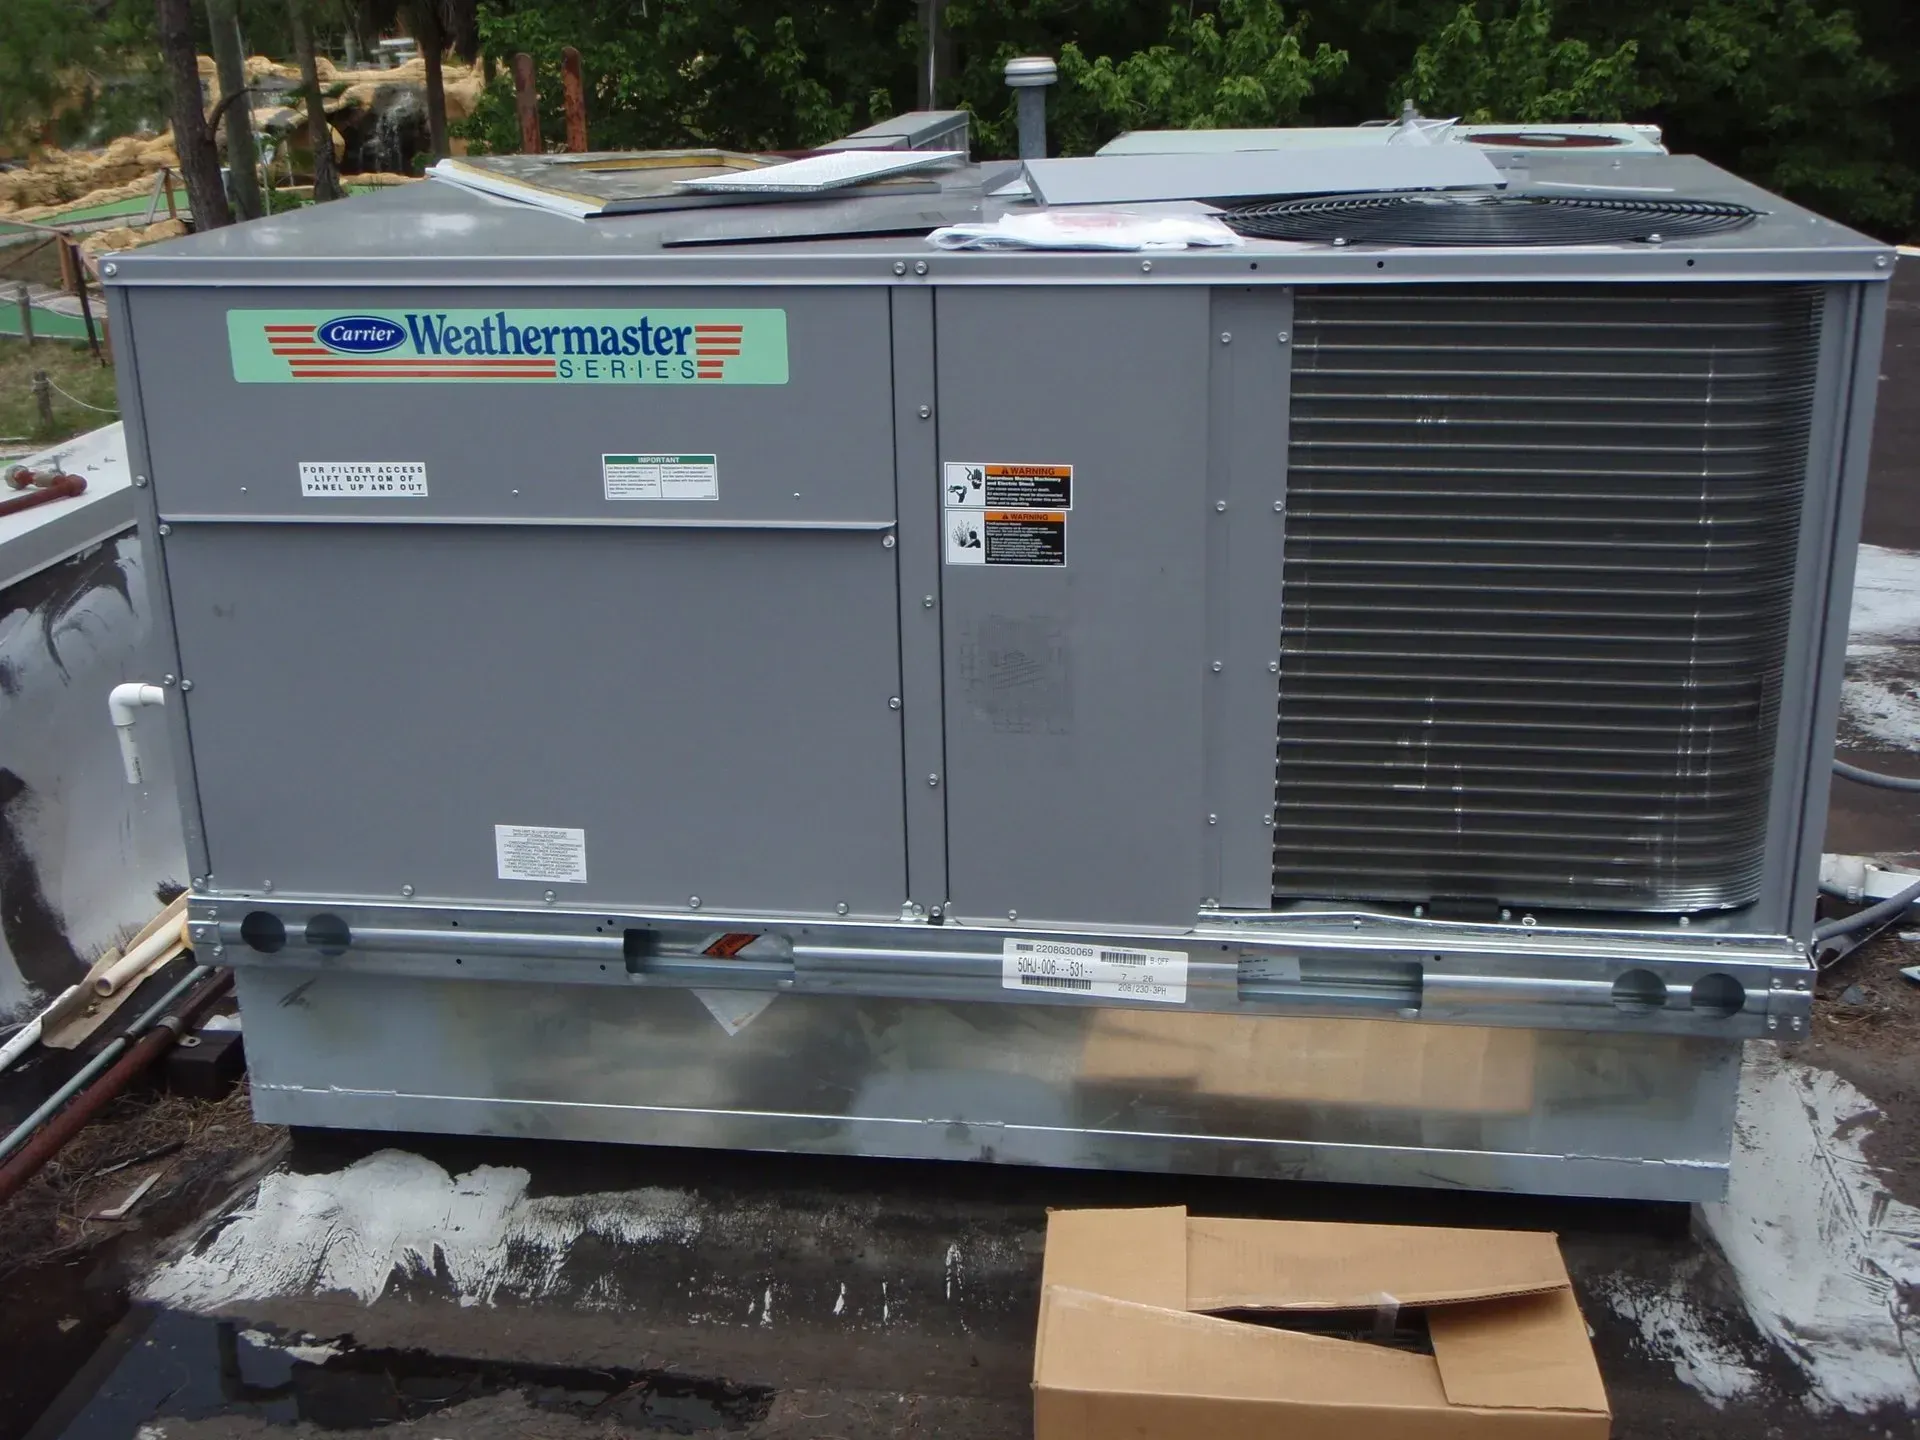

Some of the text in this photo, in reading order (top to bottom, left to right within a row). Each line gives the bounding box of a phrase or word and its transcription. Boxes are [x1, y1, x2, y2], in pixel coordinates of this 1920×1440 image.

[330, 311, 695, 357] Carrier Weathermaster
[1036, 944, 1094, 956] 2208G30069
